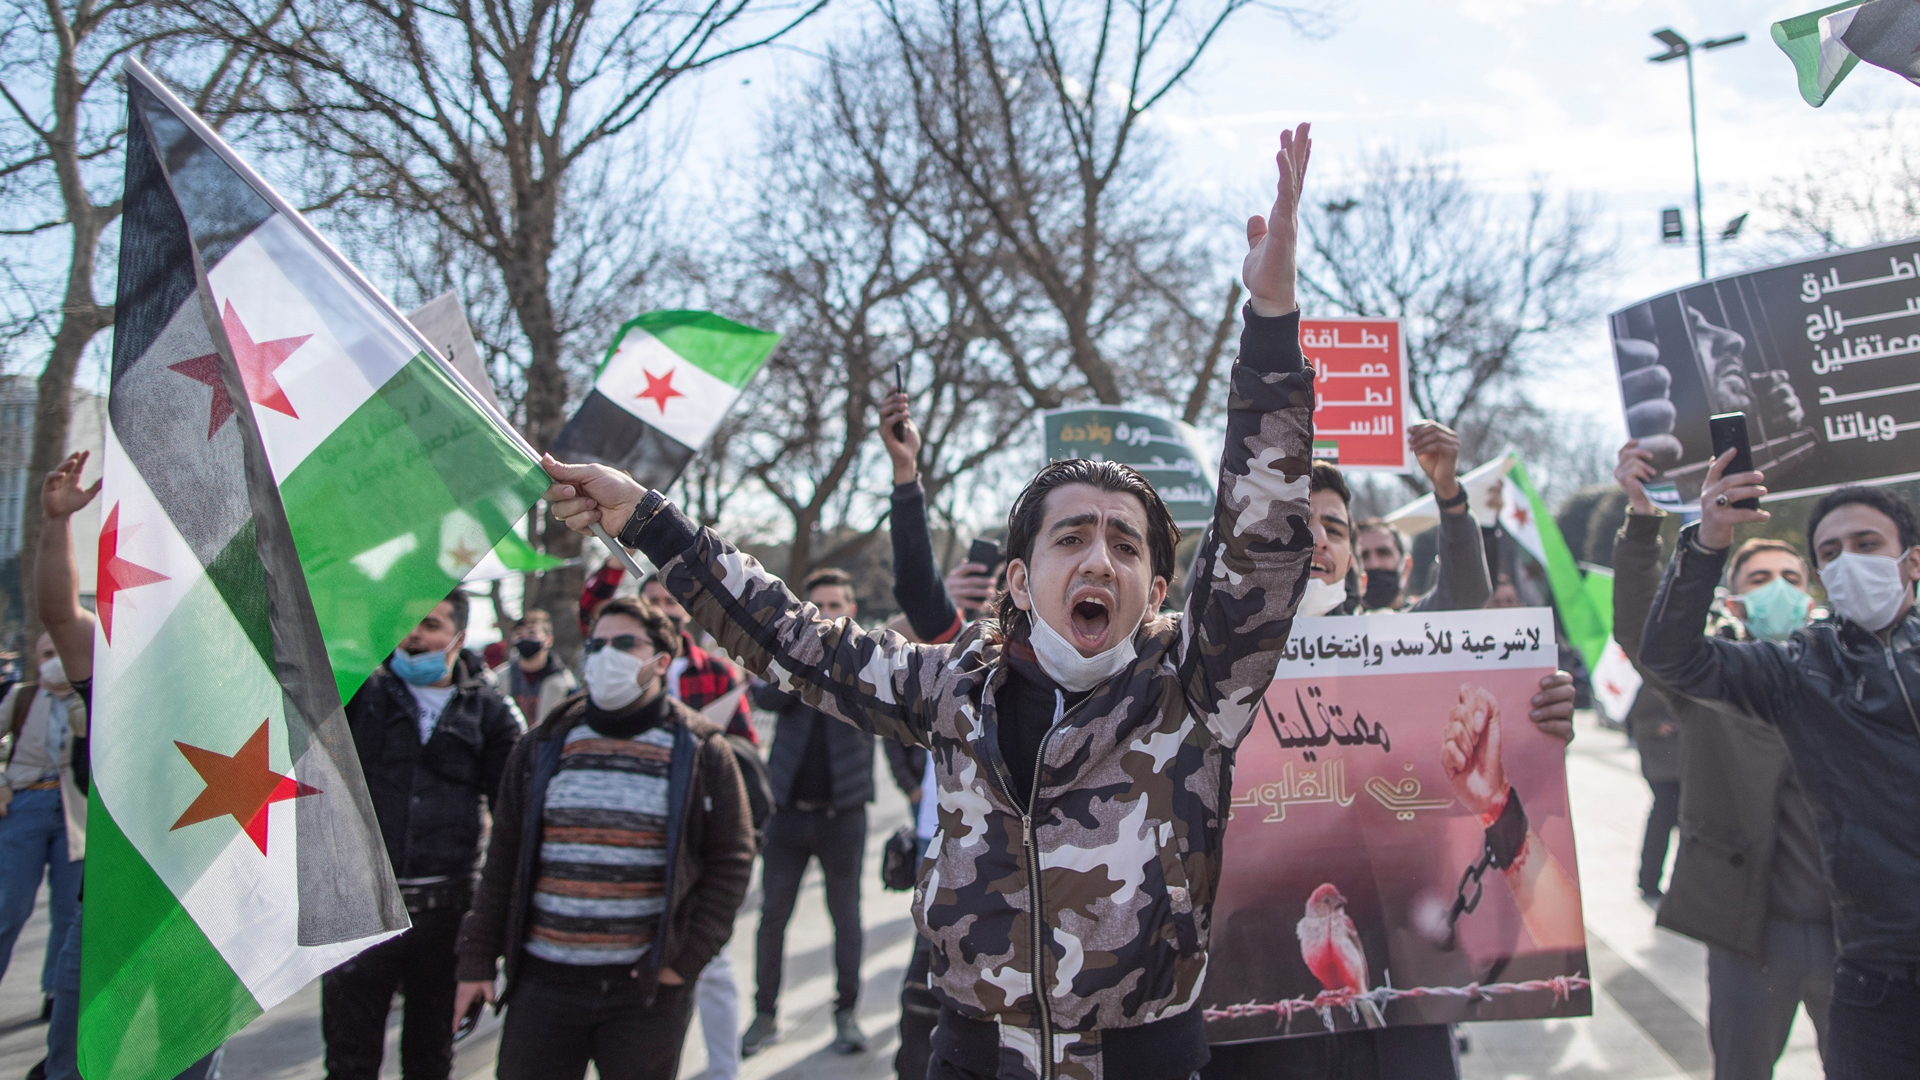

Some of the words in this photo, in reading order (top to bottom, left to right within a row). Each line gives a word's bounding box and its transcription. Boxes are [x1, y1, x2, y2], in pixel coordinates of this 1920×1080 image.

[1303, 328, 1389, 354] بطاقة
[1314, 357, 1390, 383] حمرا
[1314, 387, 1392, 412] لطر
[1313, 415, 1393, 436] الأس
[1824, 411, 1920, 442] وياتنا
[1391, 622, 1453, 657] للأسد
[1263, 685, 1391, 763] معتقلينا
[1364, 761, 1455, 821] في
